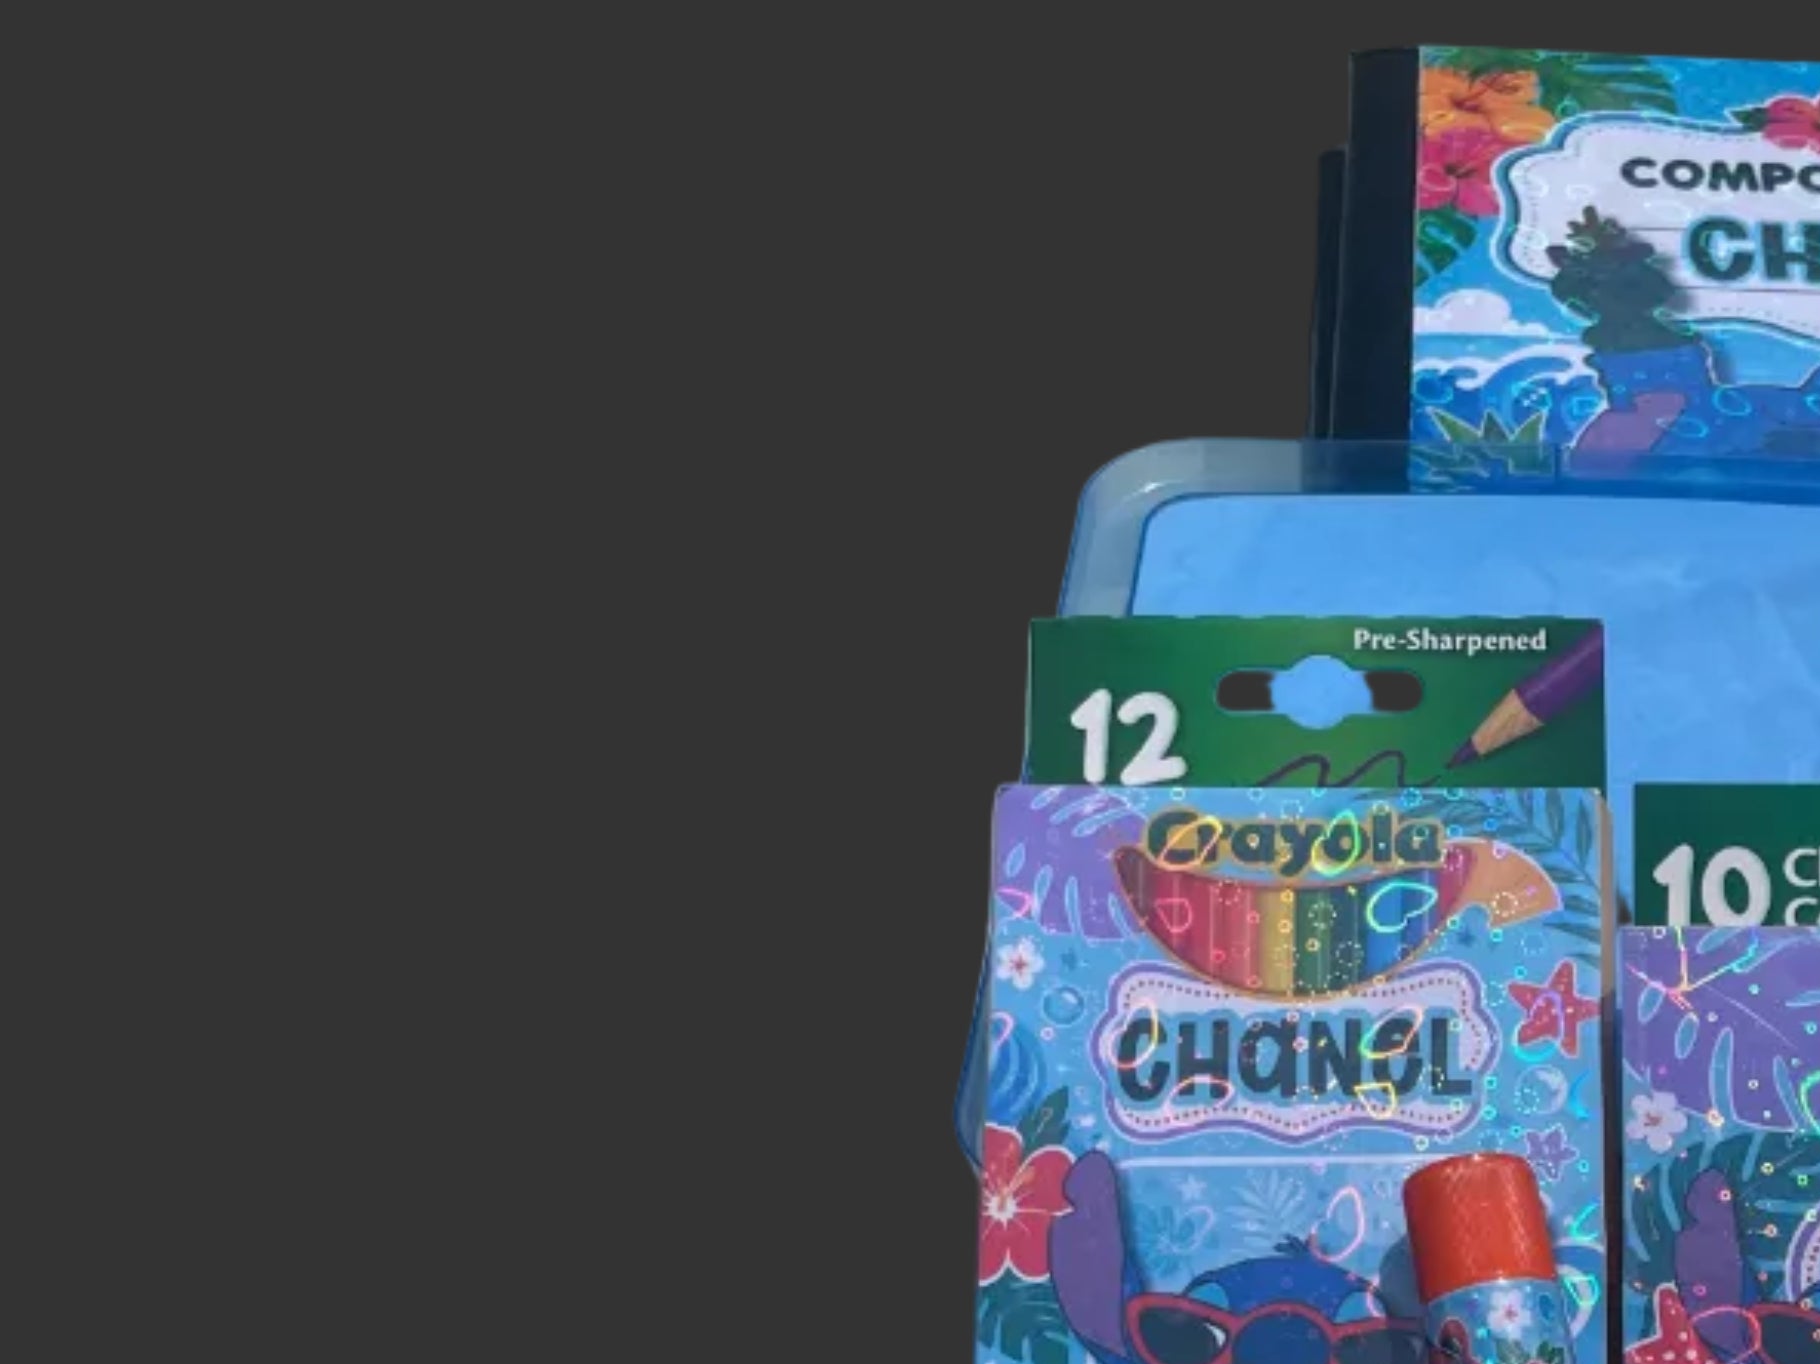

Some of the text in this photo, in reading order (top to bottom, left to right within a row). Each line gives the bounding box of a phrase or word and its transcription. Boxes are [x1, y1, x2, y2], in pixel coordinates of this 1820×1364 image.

[1353, 627, 1548, 654] Pre-Sharpened
[1069, 687, 1188, 786] 12
[1145, 809, 1443, 877] Crayola
[1652, 842, 1772, 926] 10
